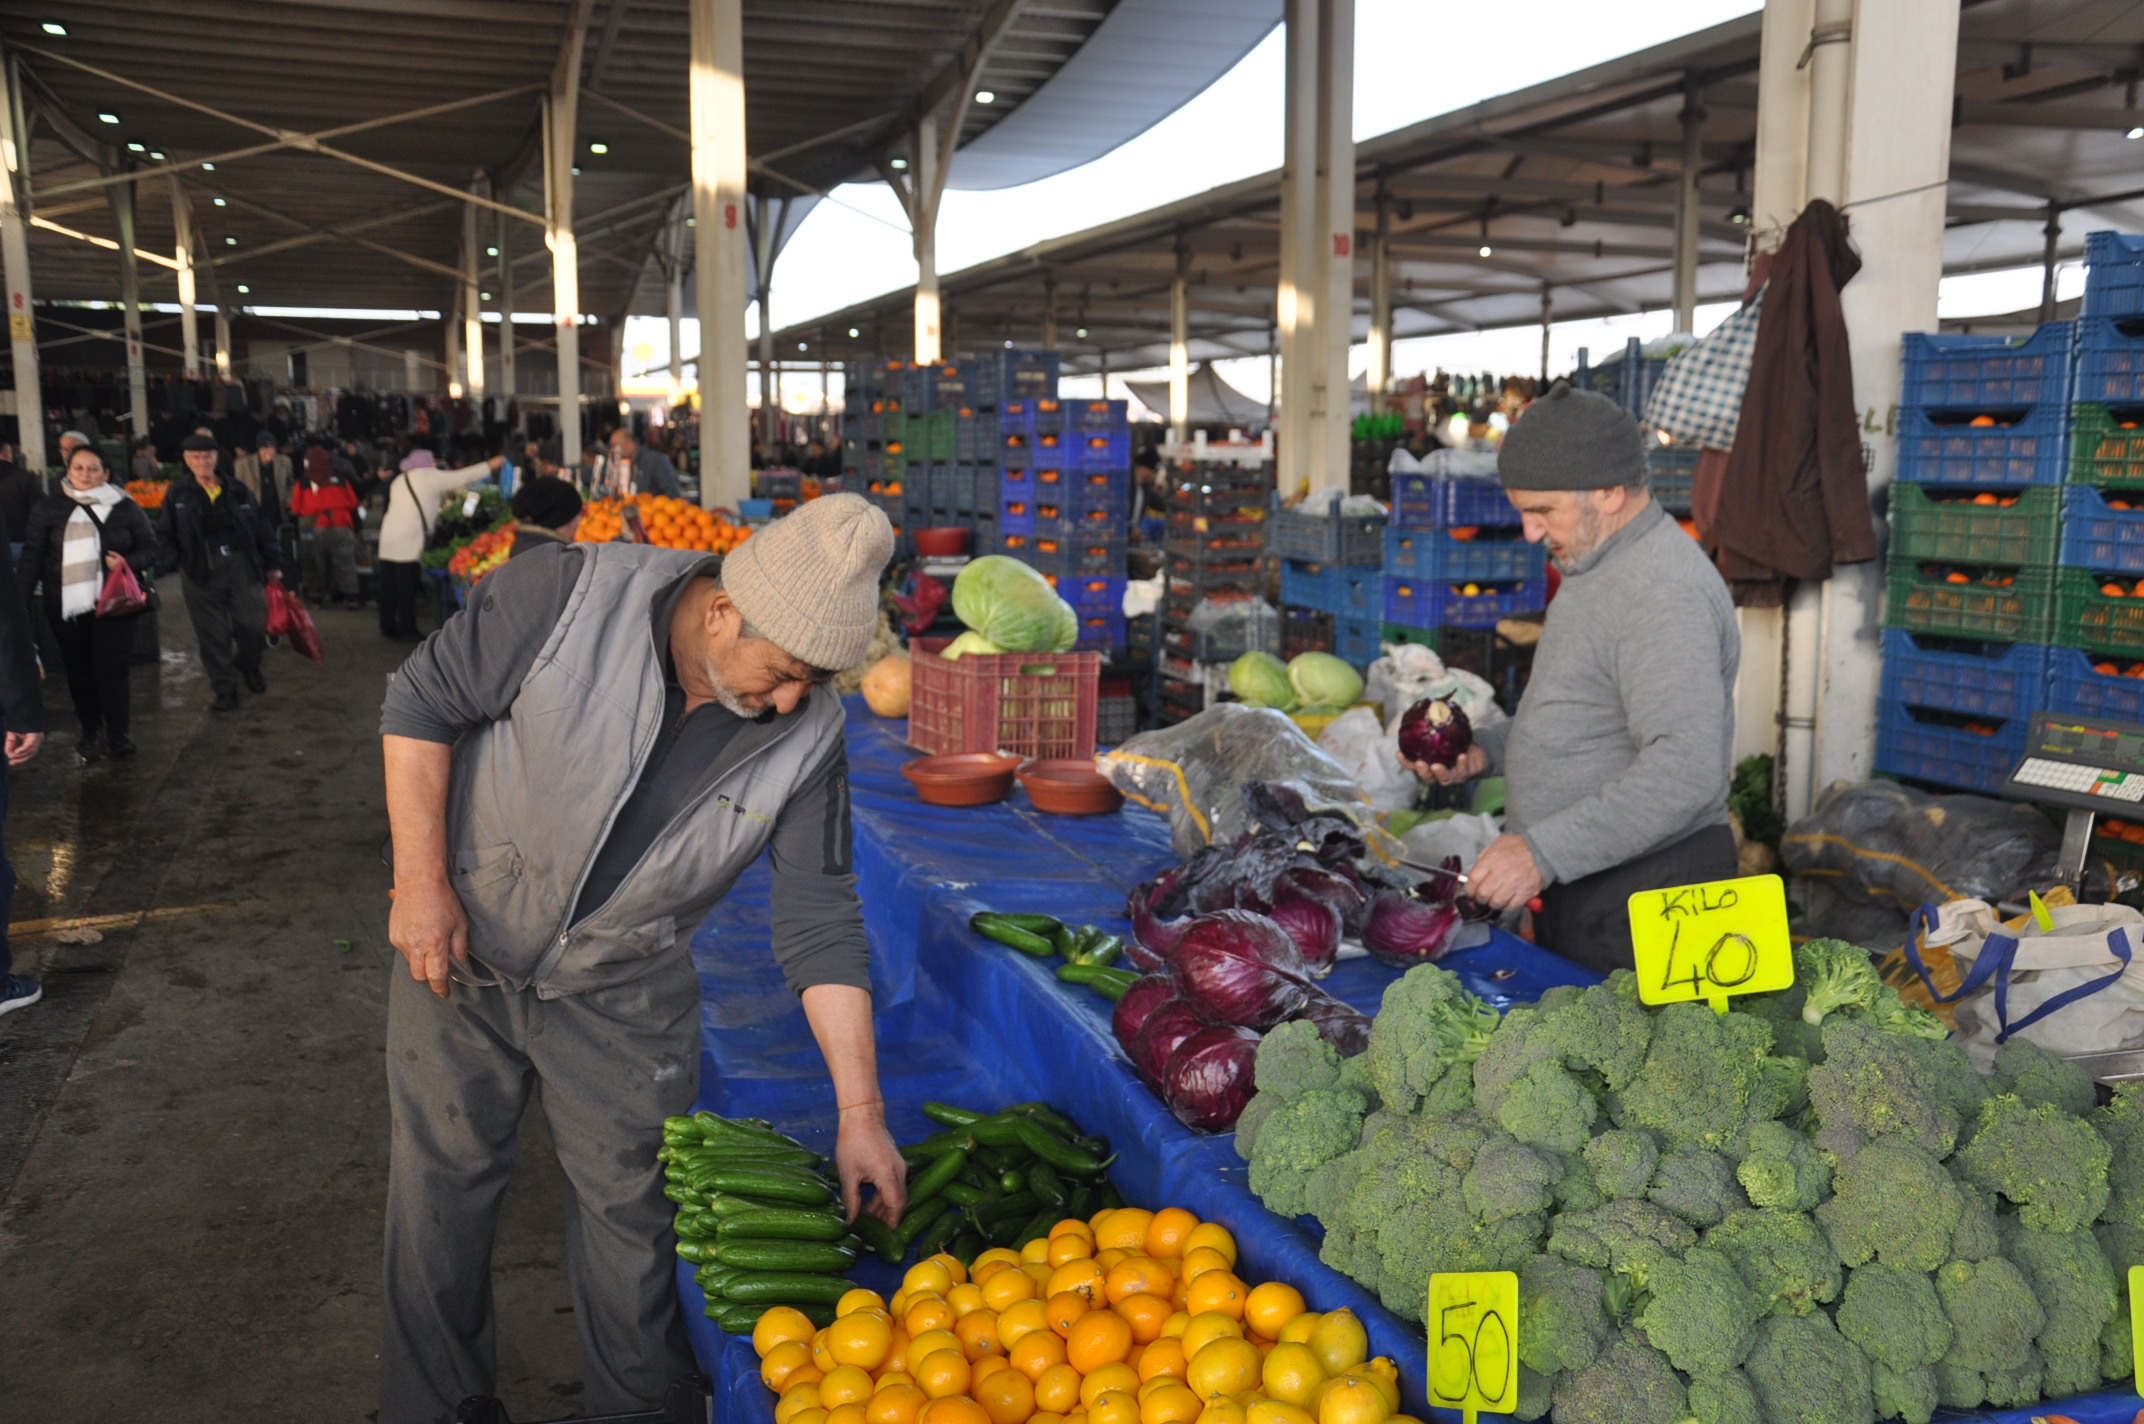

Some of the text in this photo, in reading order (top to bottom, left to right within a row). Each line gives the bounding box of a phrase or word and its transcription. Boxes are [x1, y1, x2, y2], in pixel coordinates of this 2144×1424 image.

[724, 203, 737, 230] 9
[1332, 232, 1350, 257] 10
[1661, 919, 1758, 996] 40
[1433, 1301, 1510, 1406] 50
